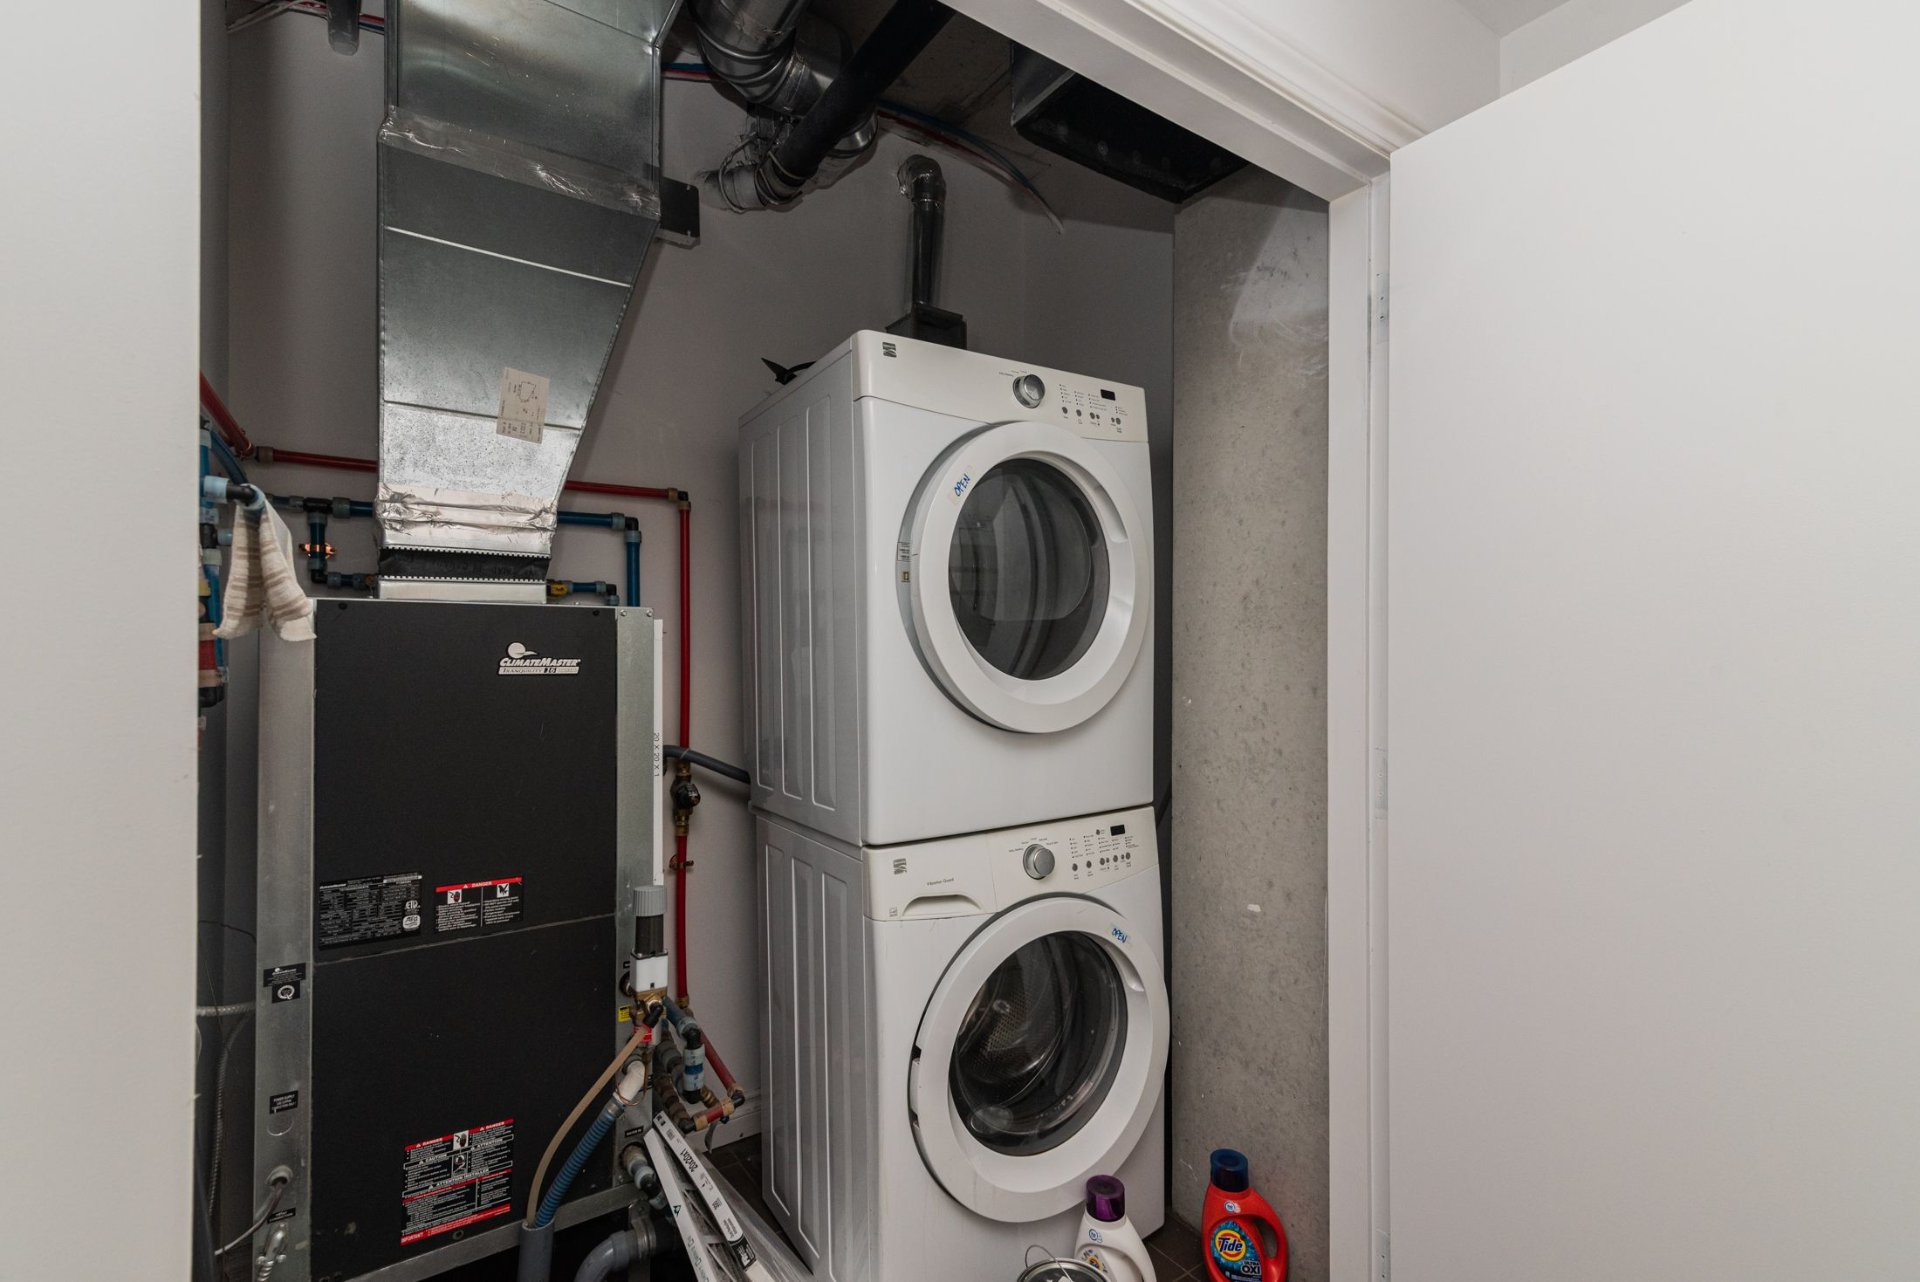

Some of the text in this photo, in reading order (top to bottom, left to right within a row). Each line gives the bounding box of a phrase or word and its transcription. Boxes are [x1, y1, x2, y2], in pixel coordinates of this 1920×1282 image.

[953, 472, 971, 497] OPEN
[1111, 927, 1128, 943] OPEN
[1218, 1235, 1243, 1252] Tide
[1241, 1265, 1261, 1275] OXI
